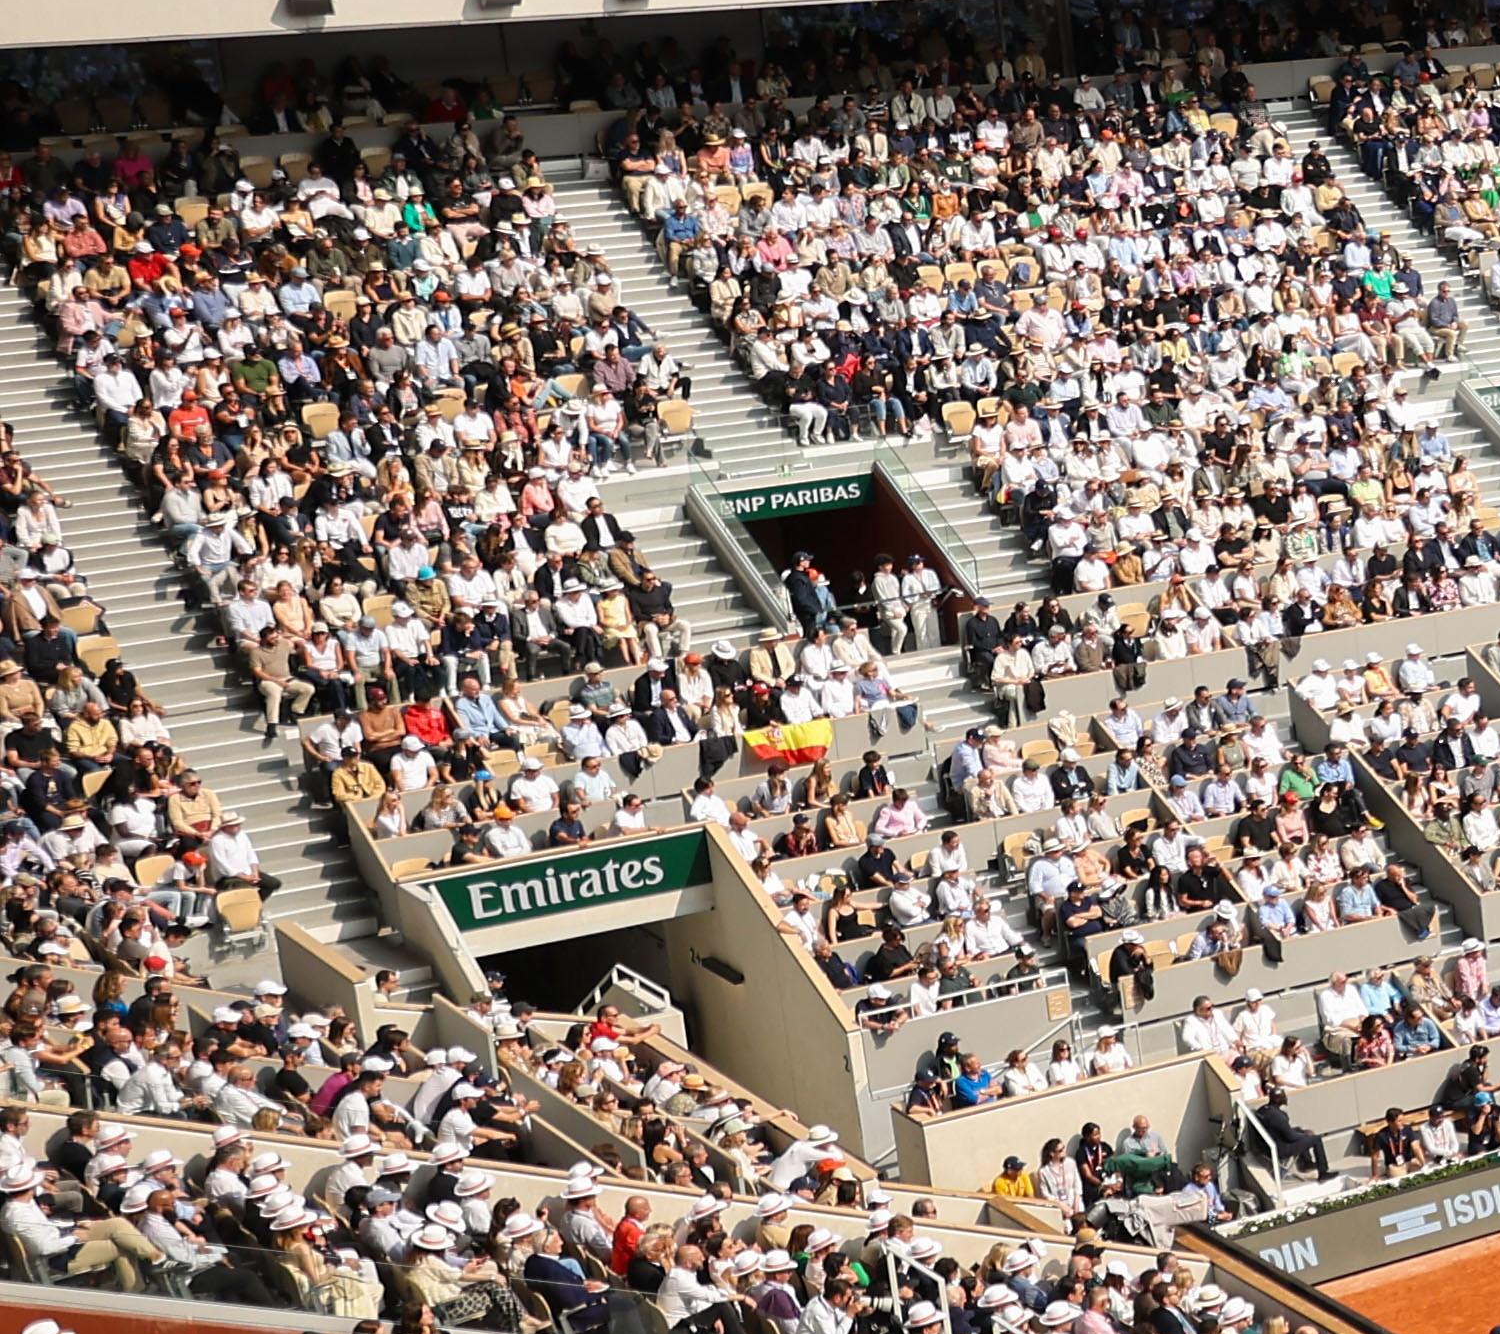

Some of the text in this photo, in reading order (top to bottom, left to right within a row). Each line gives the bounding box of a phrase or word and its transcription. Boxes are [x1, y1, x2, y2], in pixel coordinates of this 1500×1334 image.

[720, 483, 862, 516] BNP PARIBAS
[467, 854, 665, 923] Emirates
